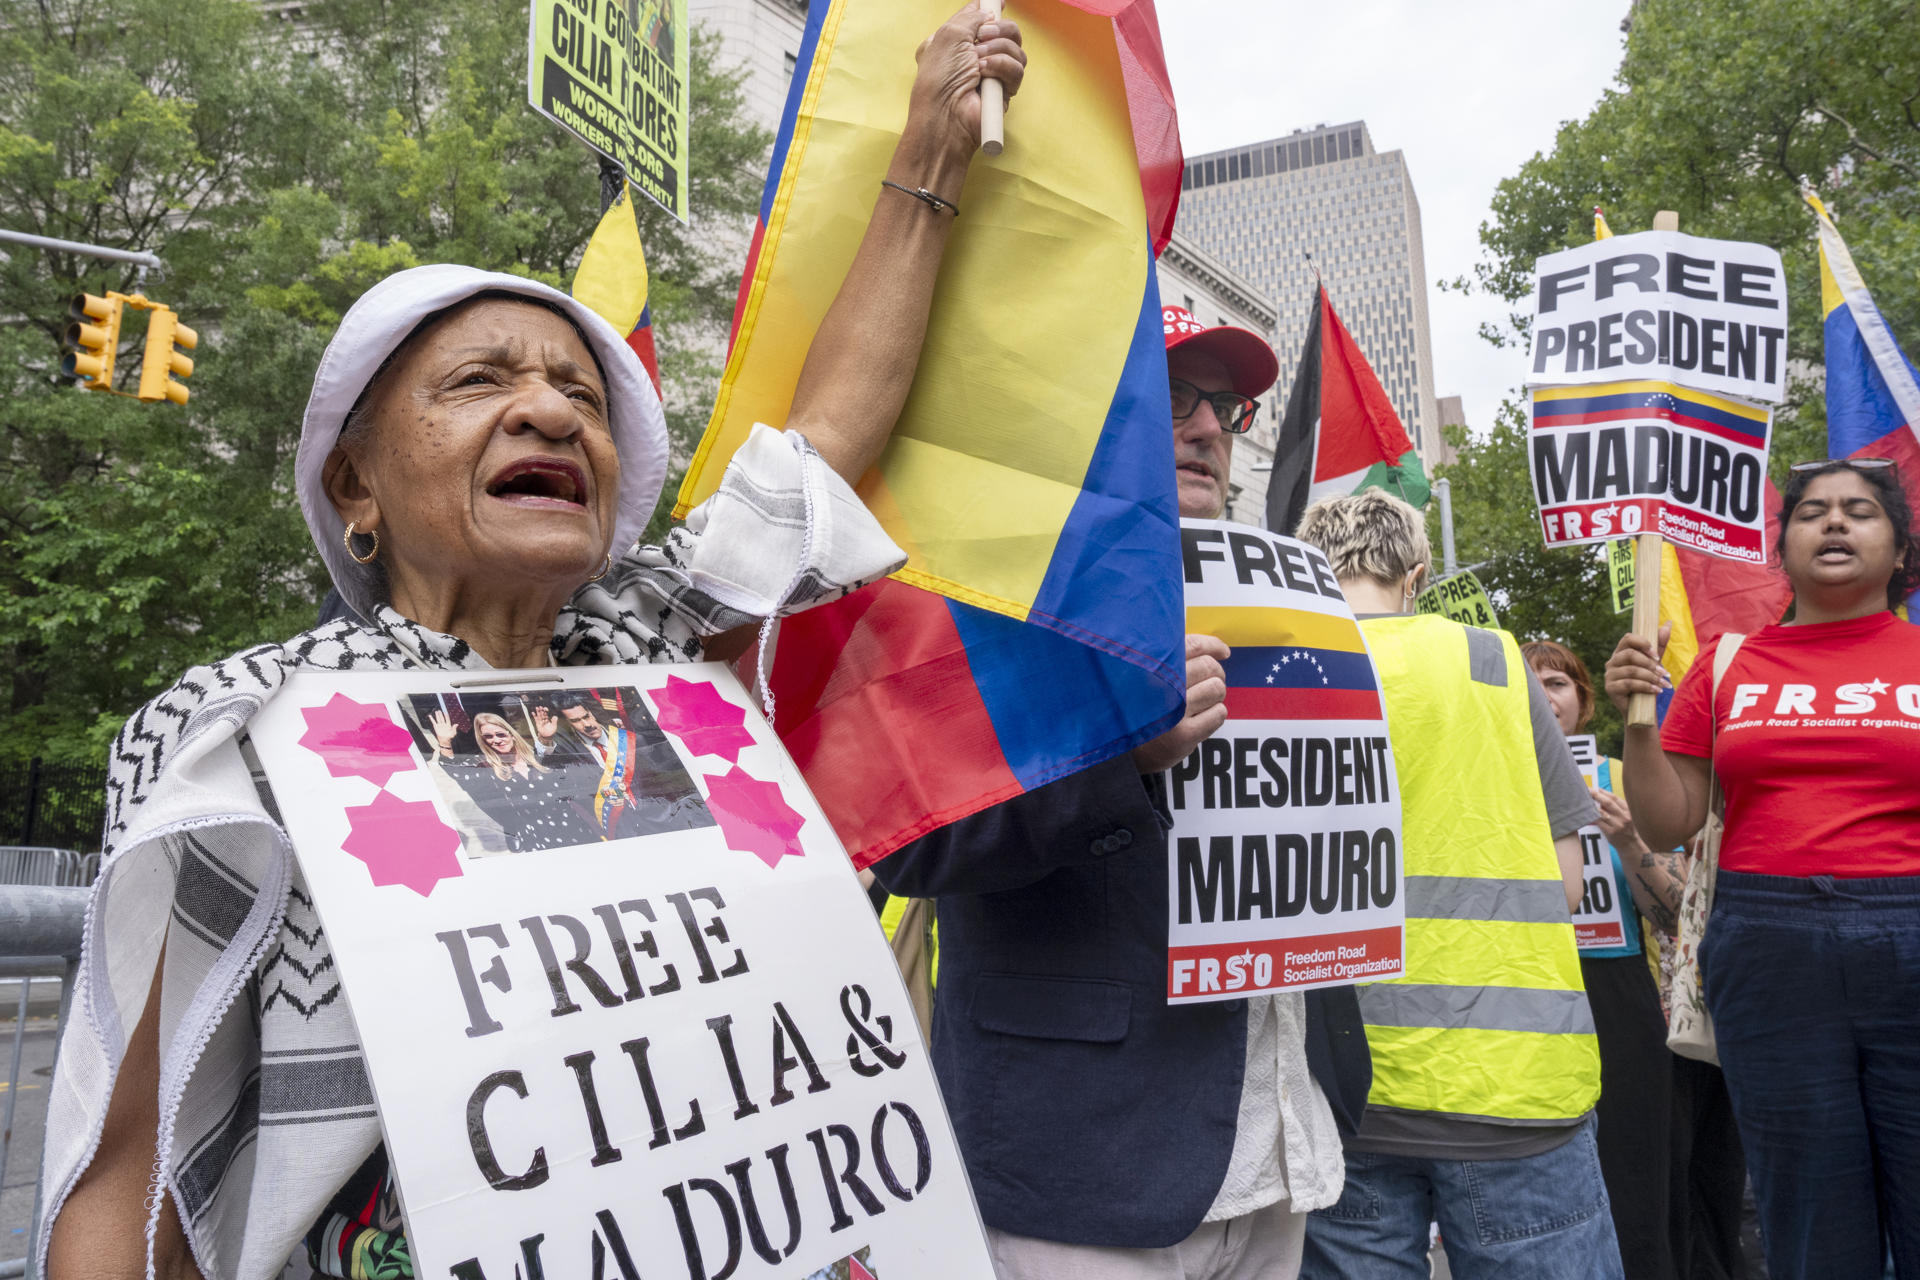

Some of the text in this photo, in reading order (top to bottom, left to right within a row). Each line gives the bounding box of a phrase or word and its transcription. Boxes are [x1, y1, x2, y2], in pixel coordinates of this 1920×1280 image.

[552, 3, 612, 97] CILIA
[552, 96, 673, 209] WORKERS WLD PARTY
[569, 81, 664, 181] WORKES.ORG
[1538, 251, 1780, 314] FREE
[1533, 309, 1785, 385] PRESIDENT
[1533, 425, 1761, 524] MADURO
[1545, 504, 1642, 541] FRSO
[1613, 546, 1632, 566] FIRS
[1658, 507, 1725, 540] Freedom Road
[1658, 521, 1762, 561] Socialist Organization
[1181, 528, 1344, 602] FREE
[1617, 564, 1635, 587] CIL
[1766, 718, 1799, 727] Road
[1801, 718, 1857, 727] Socialist
[1861, 718, 1920, 730] Organiza
[1171, 736, 1390, 811] PRESIDENT
[1177, 827, 1397, 925] MADURO
[434, 887, 750, 1038] FREE
[1172, 949, 1273, 995] FRSO
[1283, 957, 1401, 983] Socialist Organization
[1284, 944, 1366, 966] Freedom Road
[466, 983, 907, 1191] CILIA &
